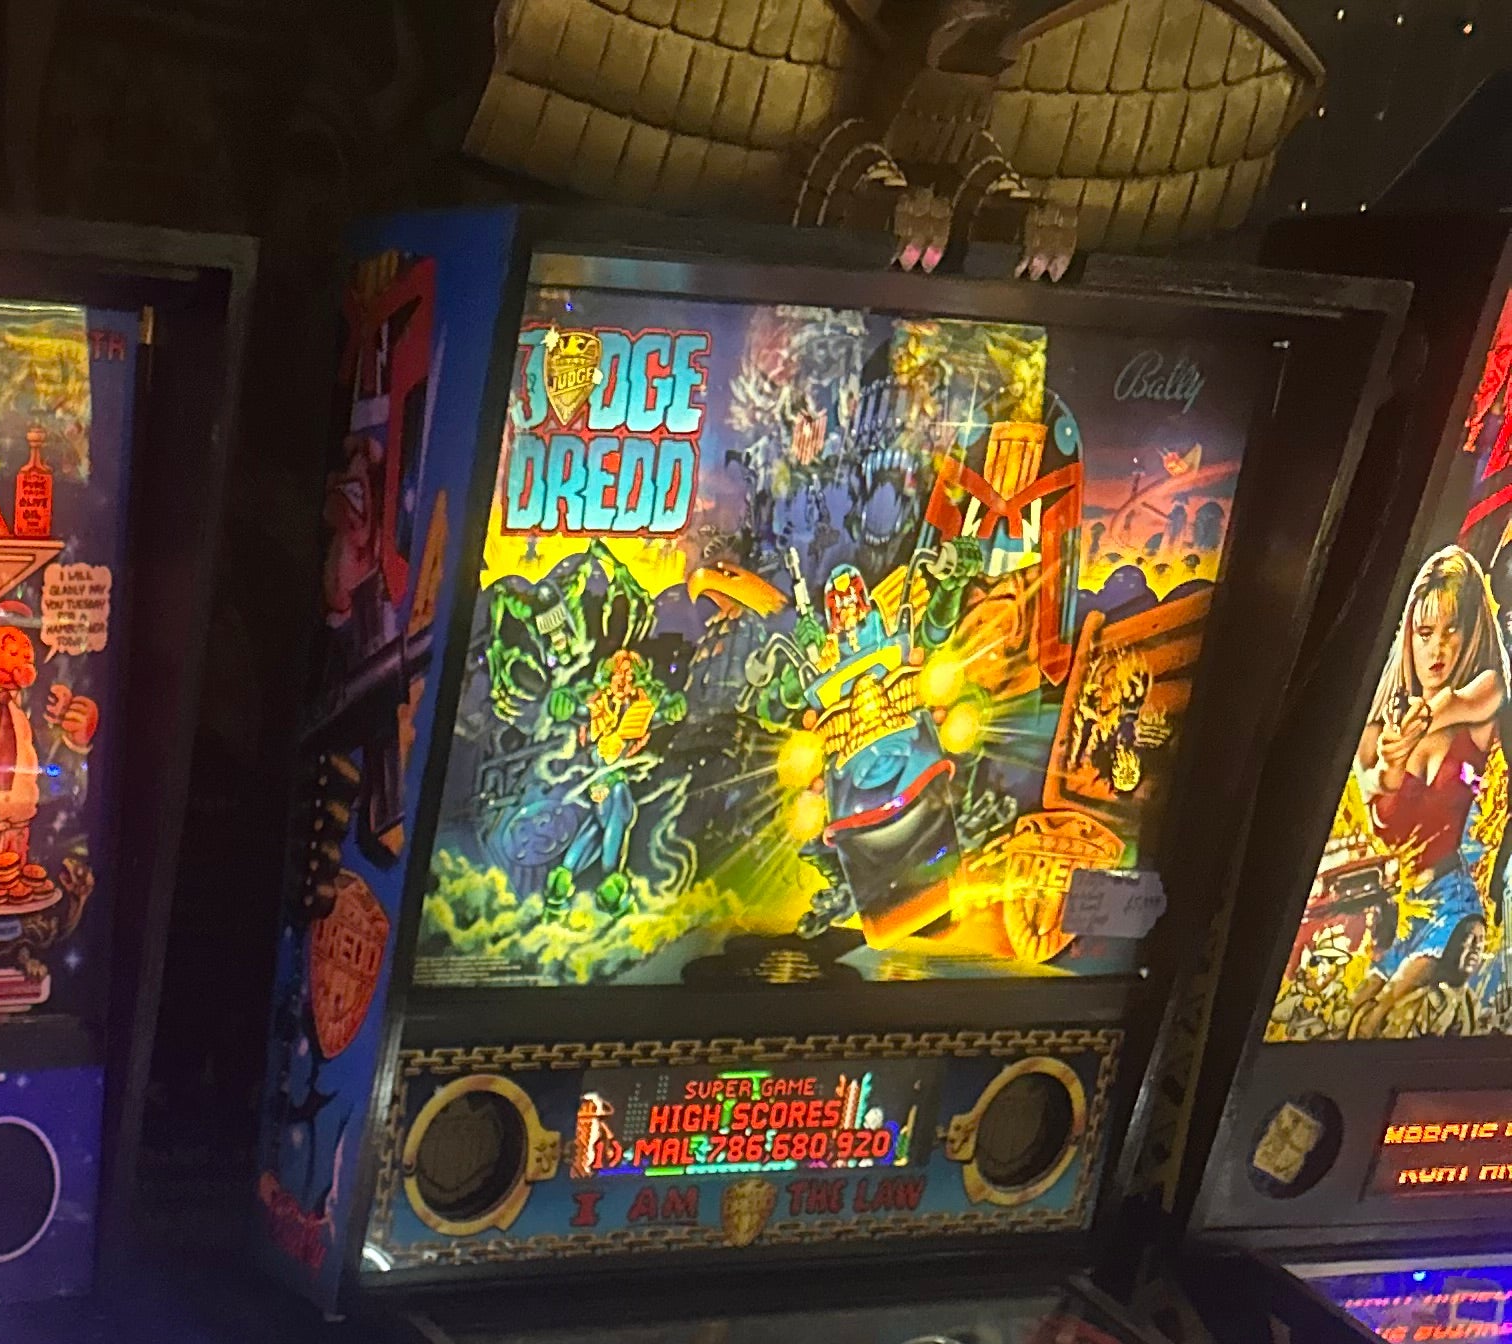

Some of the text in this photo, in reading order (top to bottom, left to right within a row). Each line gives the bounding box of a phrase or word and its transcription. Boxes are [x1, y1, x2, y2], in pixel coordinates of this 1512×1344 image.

[551, 367, 595, 391] JUDGE
[1113, 350, 1205, 407] Bally
[504, 433, 698, 534] DREDD
[684, 1077, 817, 1099] SUPER GAME
[649, 1099, 842, 1133] HIGH SCORES
[569, 1175, 928, 1227] I AM THE LAW
